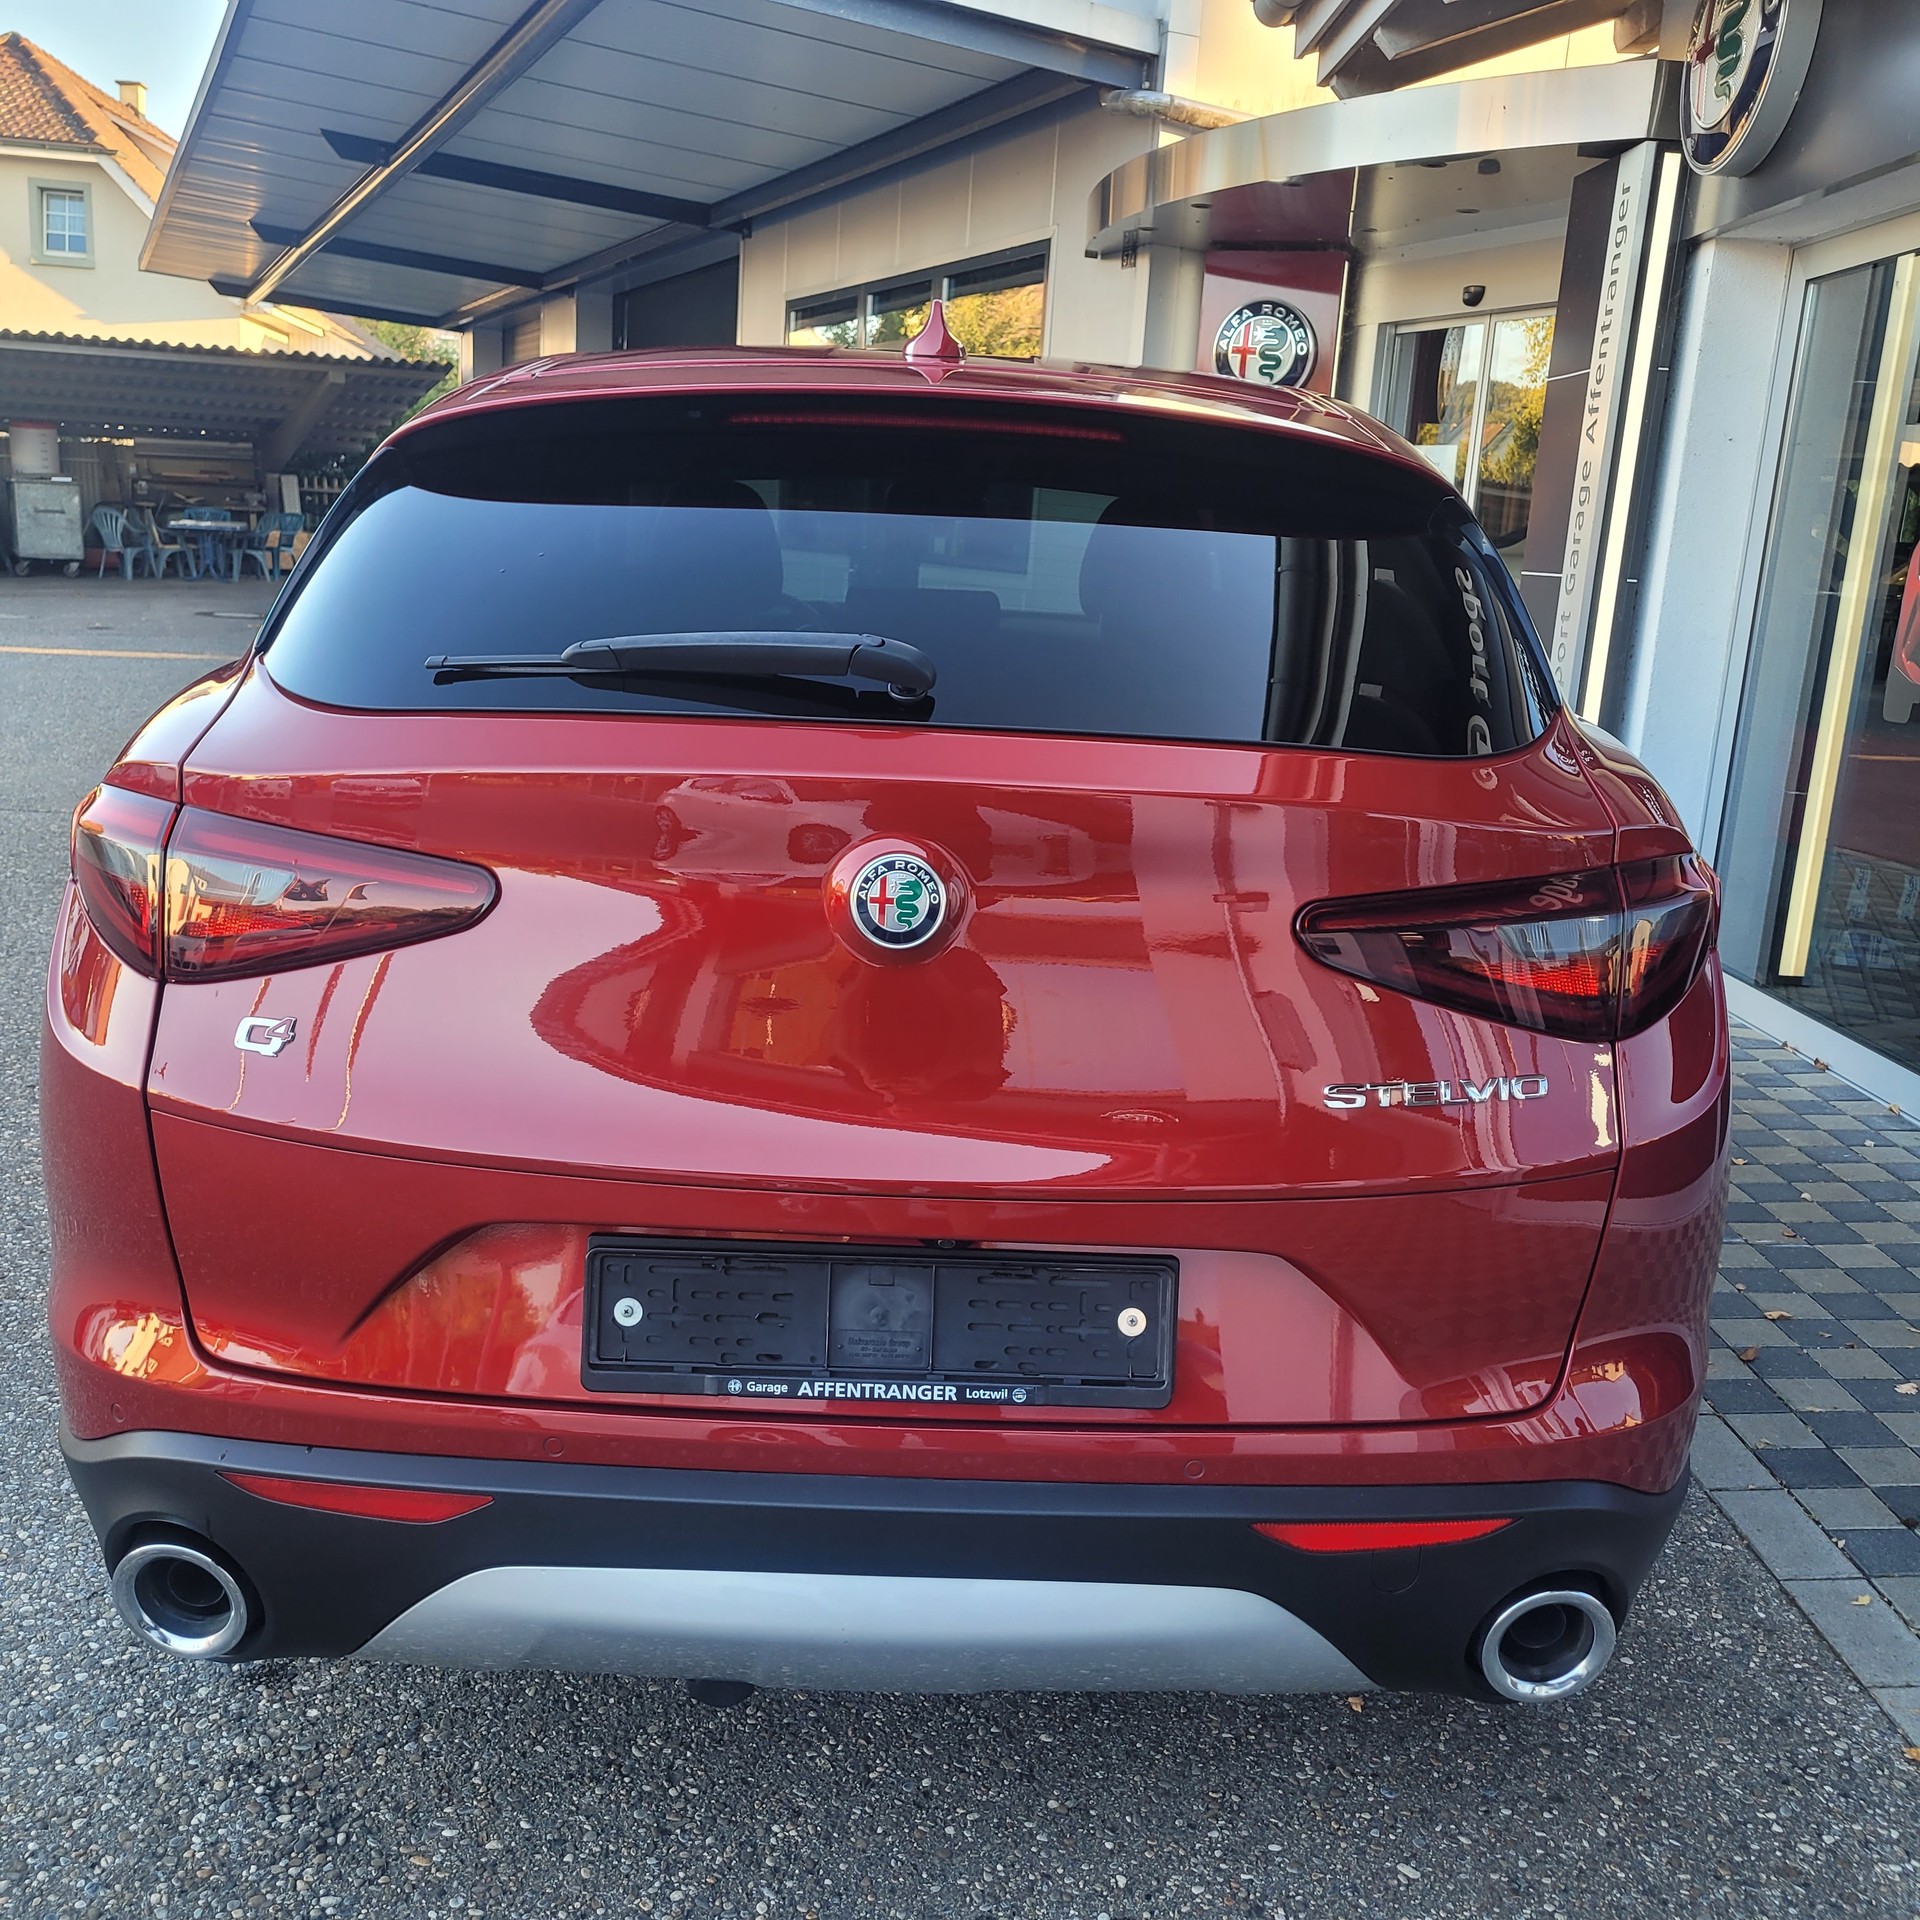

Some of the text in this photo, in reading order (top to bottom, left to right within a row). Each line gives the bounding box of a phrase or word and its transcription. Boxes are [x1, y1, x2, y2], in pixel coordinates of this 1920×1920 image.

[1218, 303, 1308, 356] ALFA ROMEO
[1555, 182, 1631, 686] port Garage Affentranger
[858, 860, 940, 905] ALFA ROMEO
[234, 1015, 298, 1058] Q4
[1322, 1073, 1550, 1110] STELVIO
[746, 1380, 1008, 1401] Garage AFFENTRANGER Lotzwil
